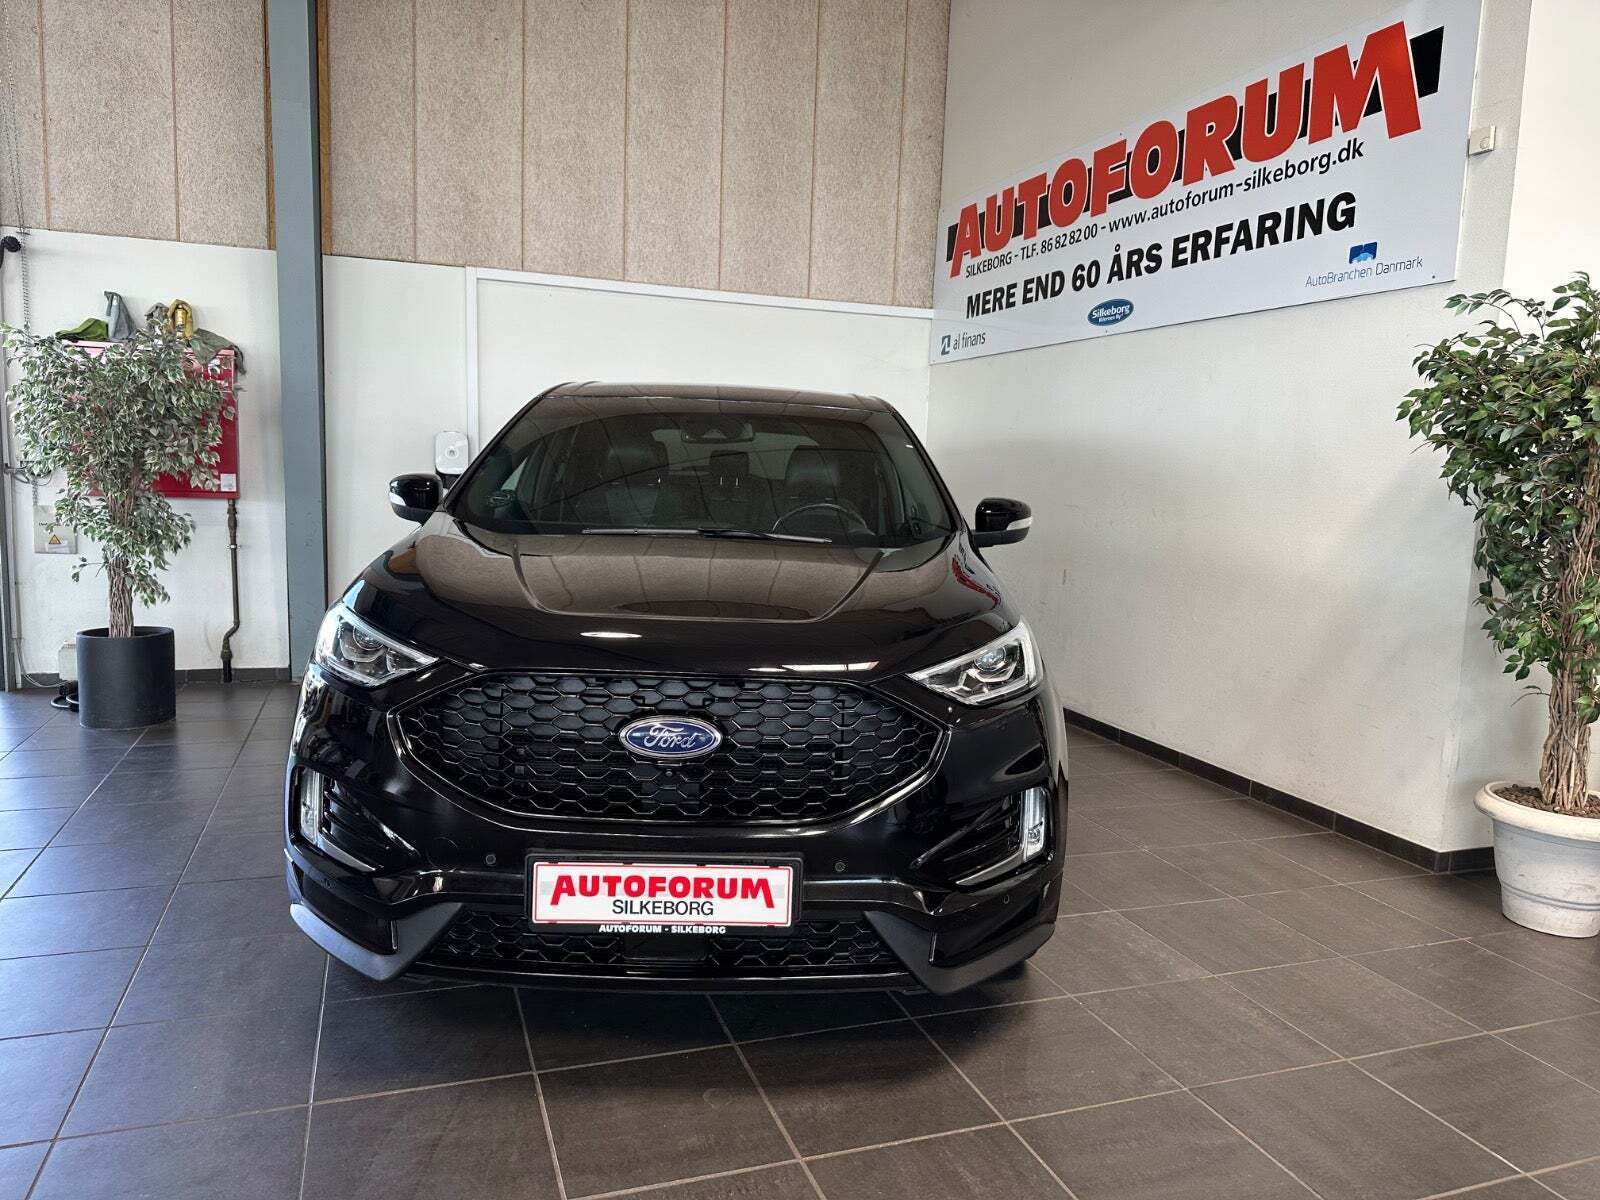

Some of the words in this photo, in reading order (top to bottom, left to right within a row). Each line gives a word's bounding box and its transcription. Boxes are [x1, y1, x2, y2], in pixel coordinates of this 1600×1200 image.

[949, 21, 1422, 278] AUTOFORUM
[965, 251, 1012, 278] SILKEBORG
[1020, 243, 1039, 261] TLF.
[1108, 138, 1365, 233] www.autoforum-silkeborg.dk
[966, 282, 1018, 319] MERE
[1022, 270, 1065, 305] END
[1072, 259, 1101, 292] 60
[1107, 243, 1163, 284] ÅRS
[1171, 191, 1357, 268] ERFARING
[1305, 267, 1372, 287] AutoBranchen
[1375, 256, 1423, 276] Danmark
[1092, 304, 1131, 319] Silkeborg
[952, 332, 961, 350] al
[961, 331, 986, 348] finans
[643, 724, 699, 749] Ford
[550, 875, 775, 909] AUTOFORUM
[612, 899, 714, 916] SILKEBORG
[598, 924, 662, 933] AUTOFORUM
[671, 925, 727, 934] SILKEBORG
